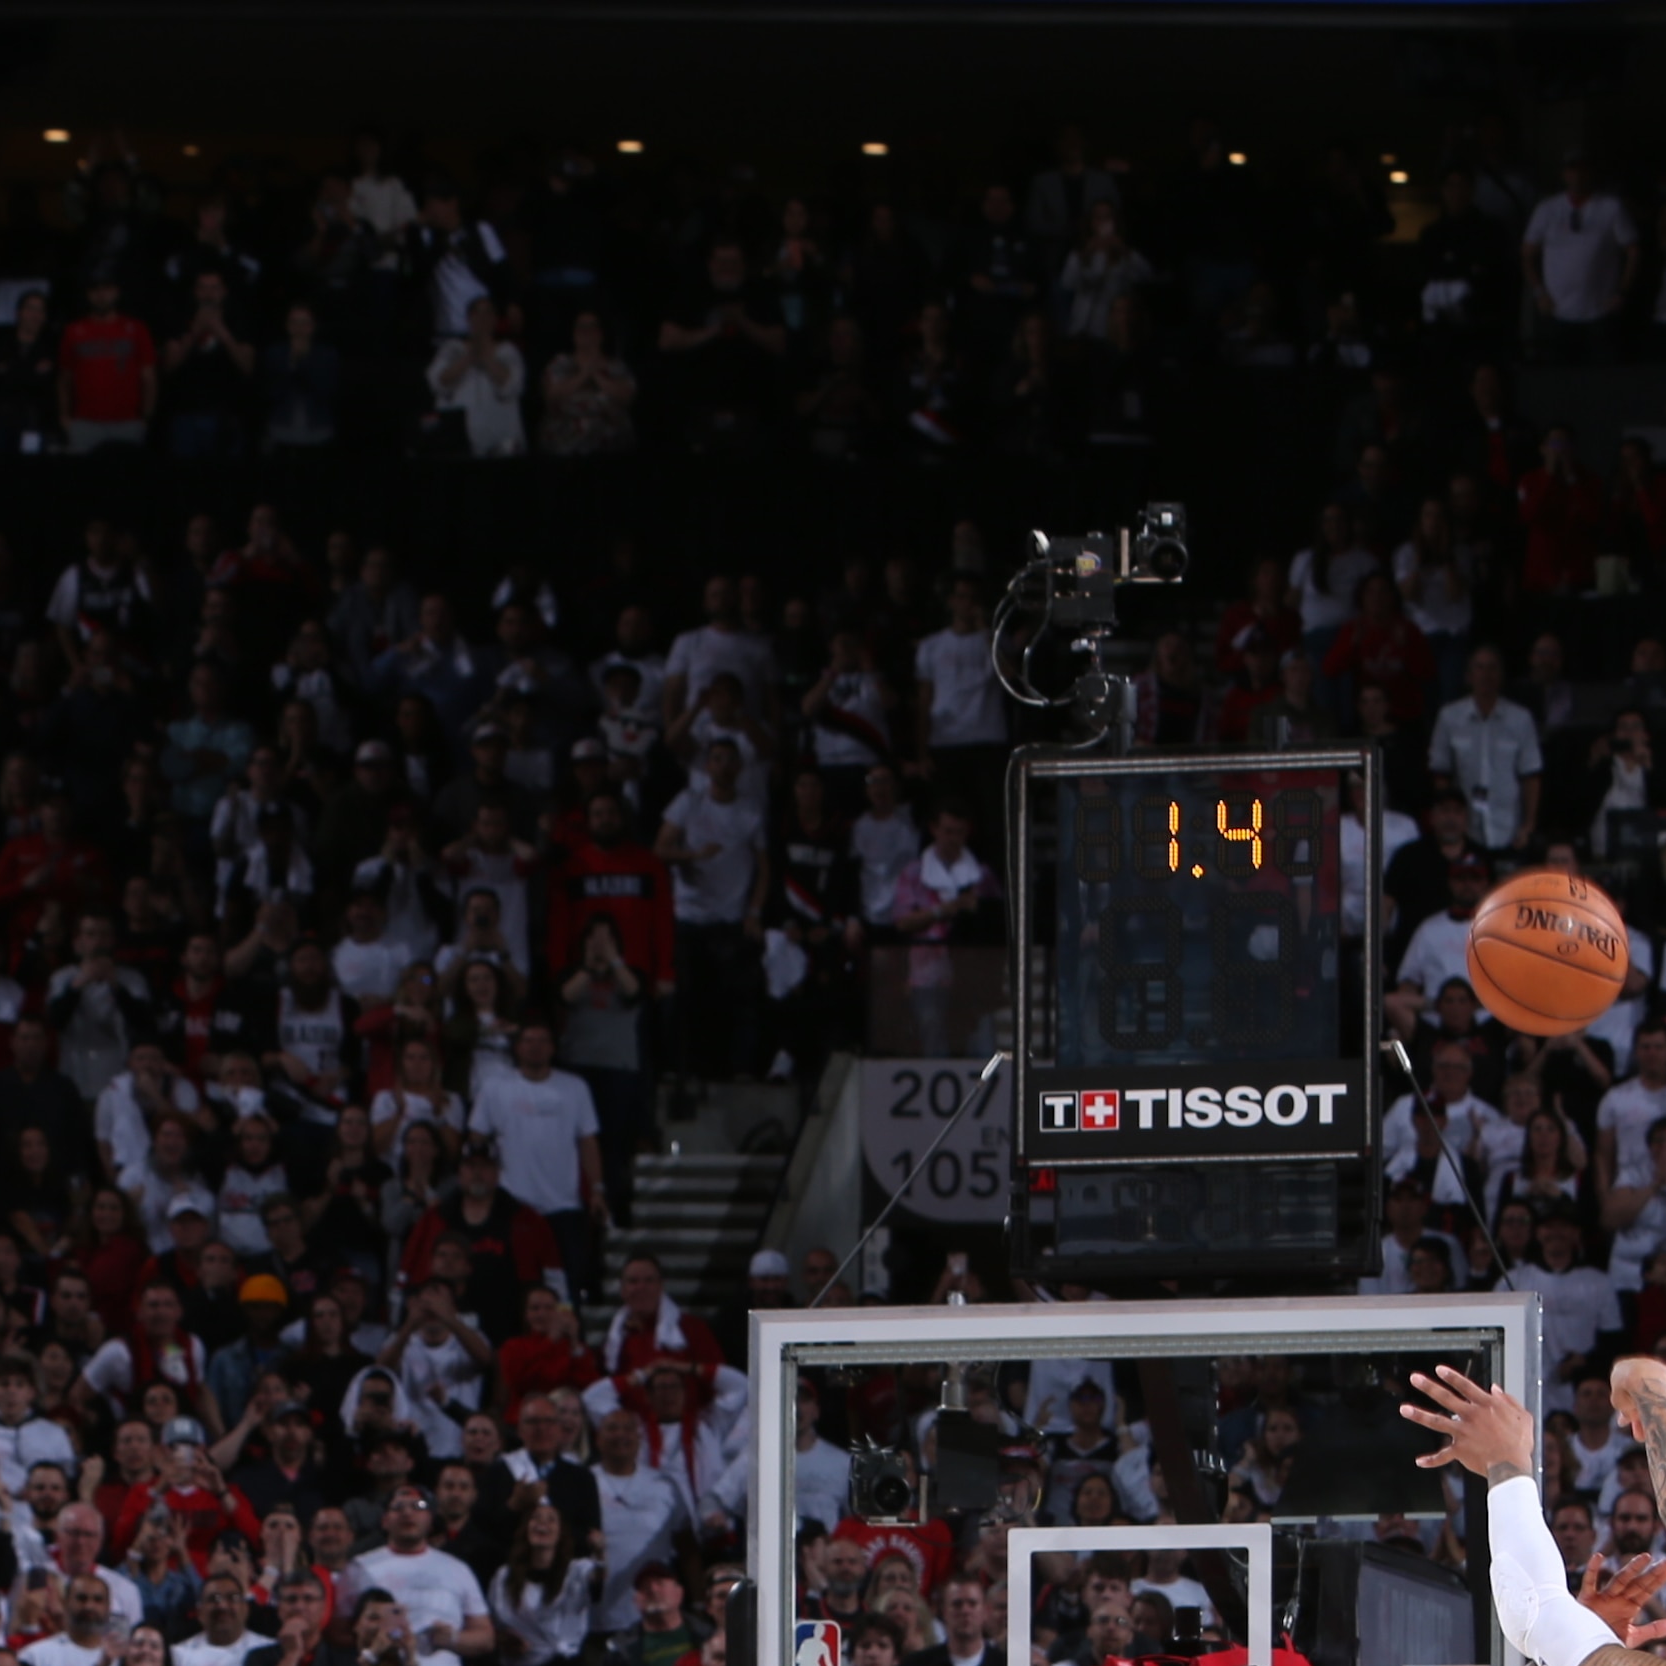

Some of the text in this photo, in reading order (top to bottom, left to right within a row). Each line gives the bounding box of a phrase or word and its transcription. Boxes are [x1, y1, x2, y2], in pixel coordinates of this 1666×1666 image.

[1168, 799, 1263, 879] 1.4
[890, 1071, 1002, 1119] 207
[1125, 1083, 1348, 1130] TISSOT
[891, 1151, 1001, 1200] 105
